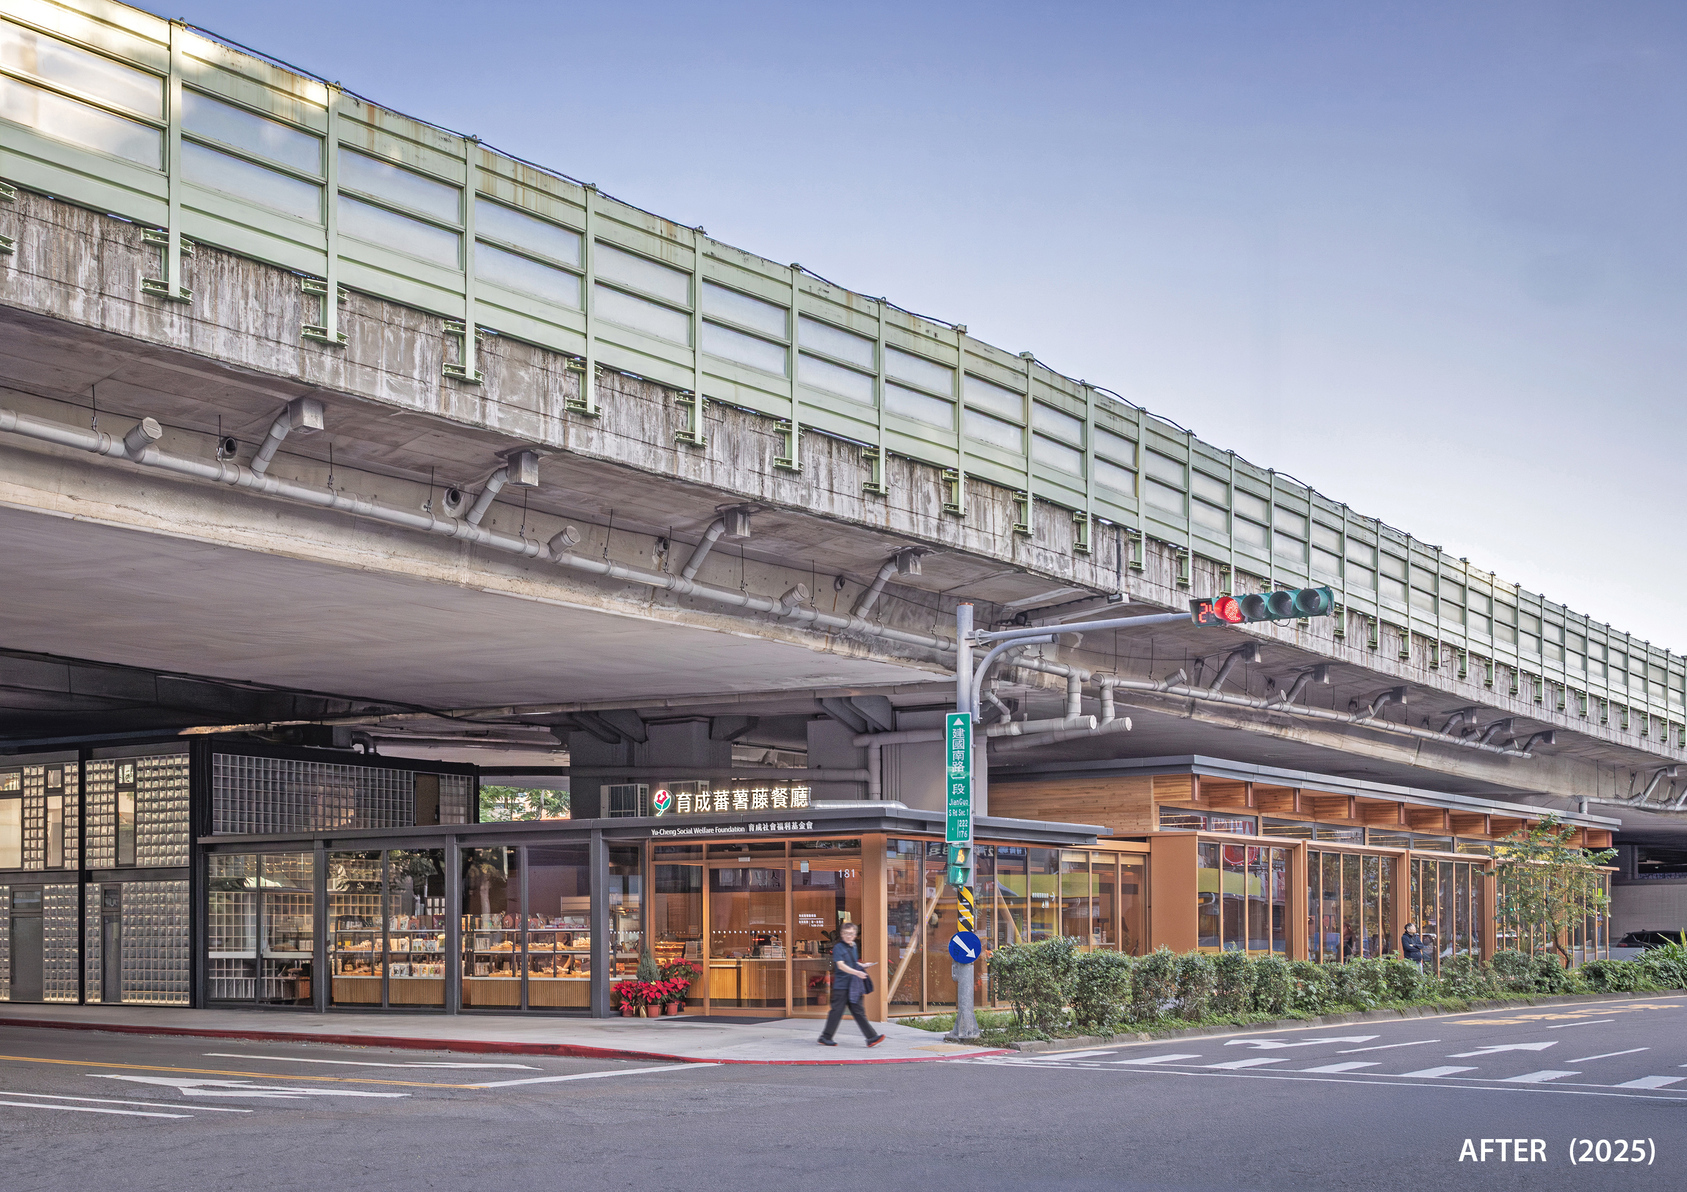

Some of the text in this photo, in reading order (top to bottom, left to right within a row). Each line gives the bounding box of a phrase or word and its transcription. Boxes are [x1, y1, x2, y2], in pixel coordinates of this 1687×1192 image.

[952, 727, 965, 795] 建國南路一段
[675, 786, 809, 813] 育成蕃薯藤餐廳
[748, 820, 814, 832] 育成社會福利基金會
[959, 819, 968, 827] 222
[651, 828, 677, 836] Yu-Cheng
[677, 827, 693, 835] Social
[693, 826, 714, 834] Welfare
[838, 868, 855, 878] 181
